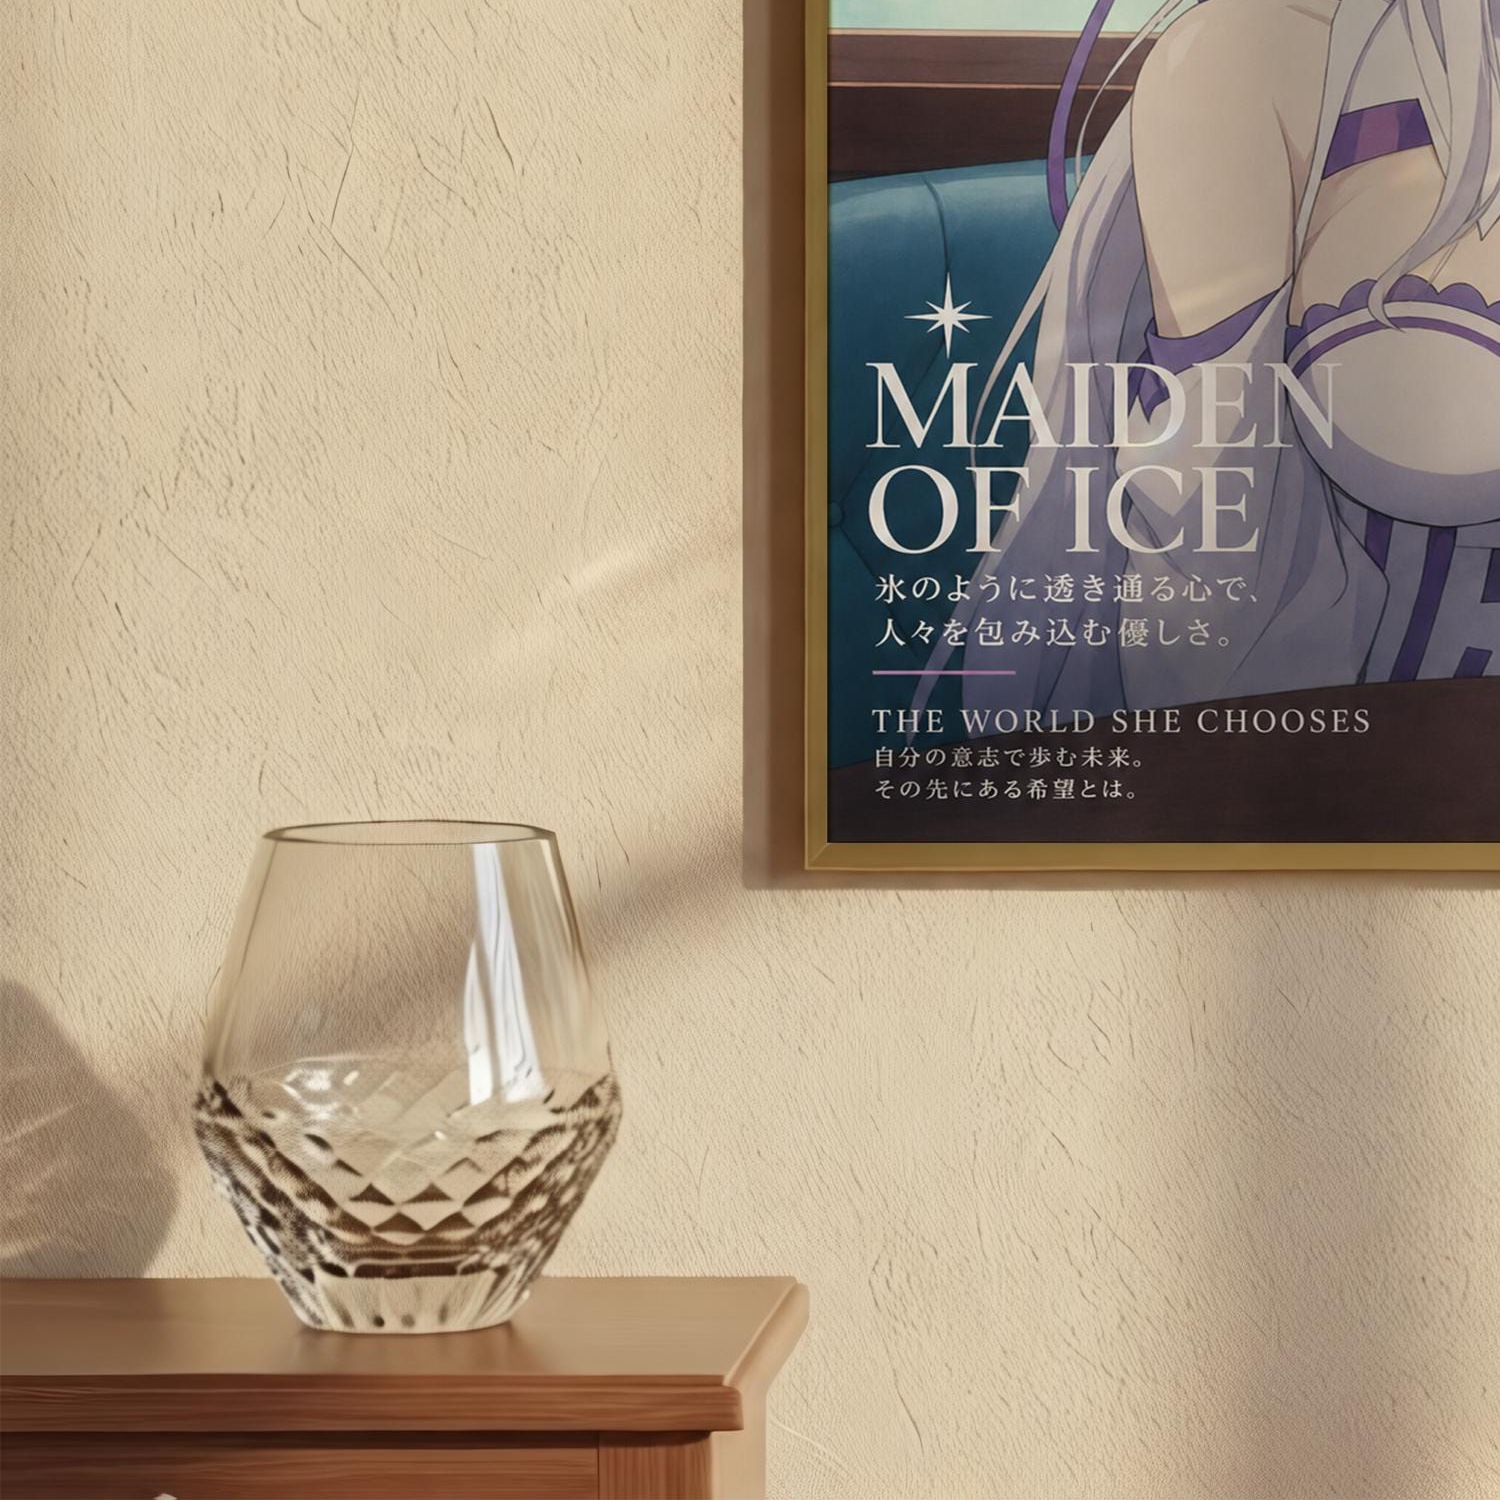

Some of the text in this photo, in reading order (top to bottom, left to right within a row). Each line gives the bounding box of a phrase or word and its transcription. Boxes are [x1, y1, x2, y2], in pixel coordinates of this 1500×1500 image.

[864, 361, 1344, 449] MAIDEN
[867, 464, 1260, 555] OF ICE
[874, 573, 1259, 604] 氷のように透き通る心で、
[874, 617, 1232, 648] 人々を包み込む優しさ。
[871, 708, 1371, 734] THE WORLD SHE CHOOSES
[874, 745, 1143, 769] 自分の意志で歩む未来。
[874, 778, 1137, 801] その先にある希望とは。
